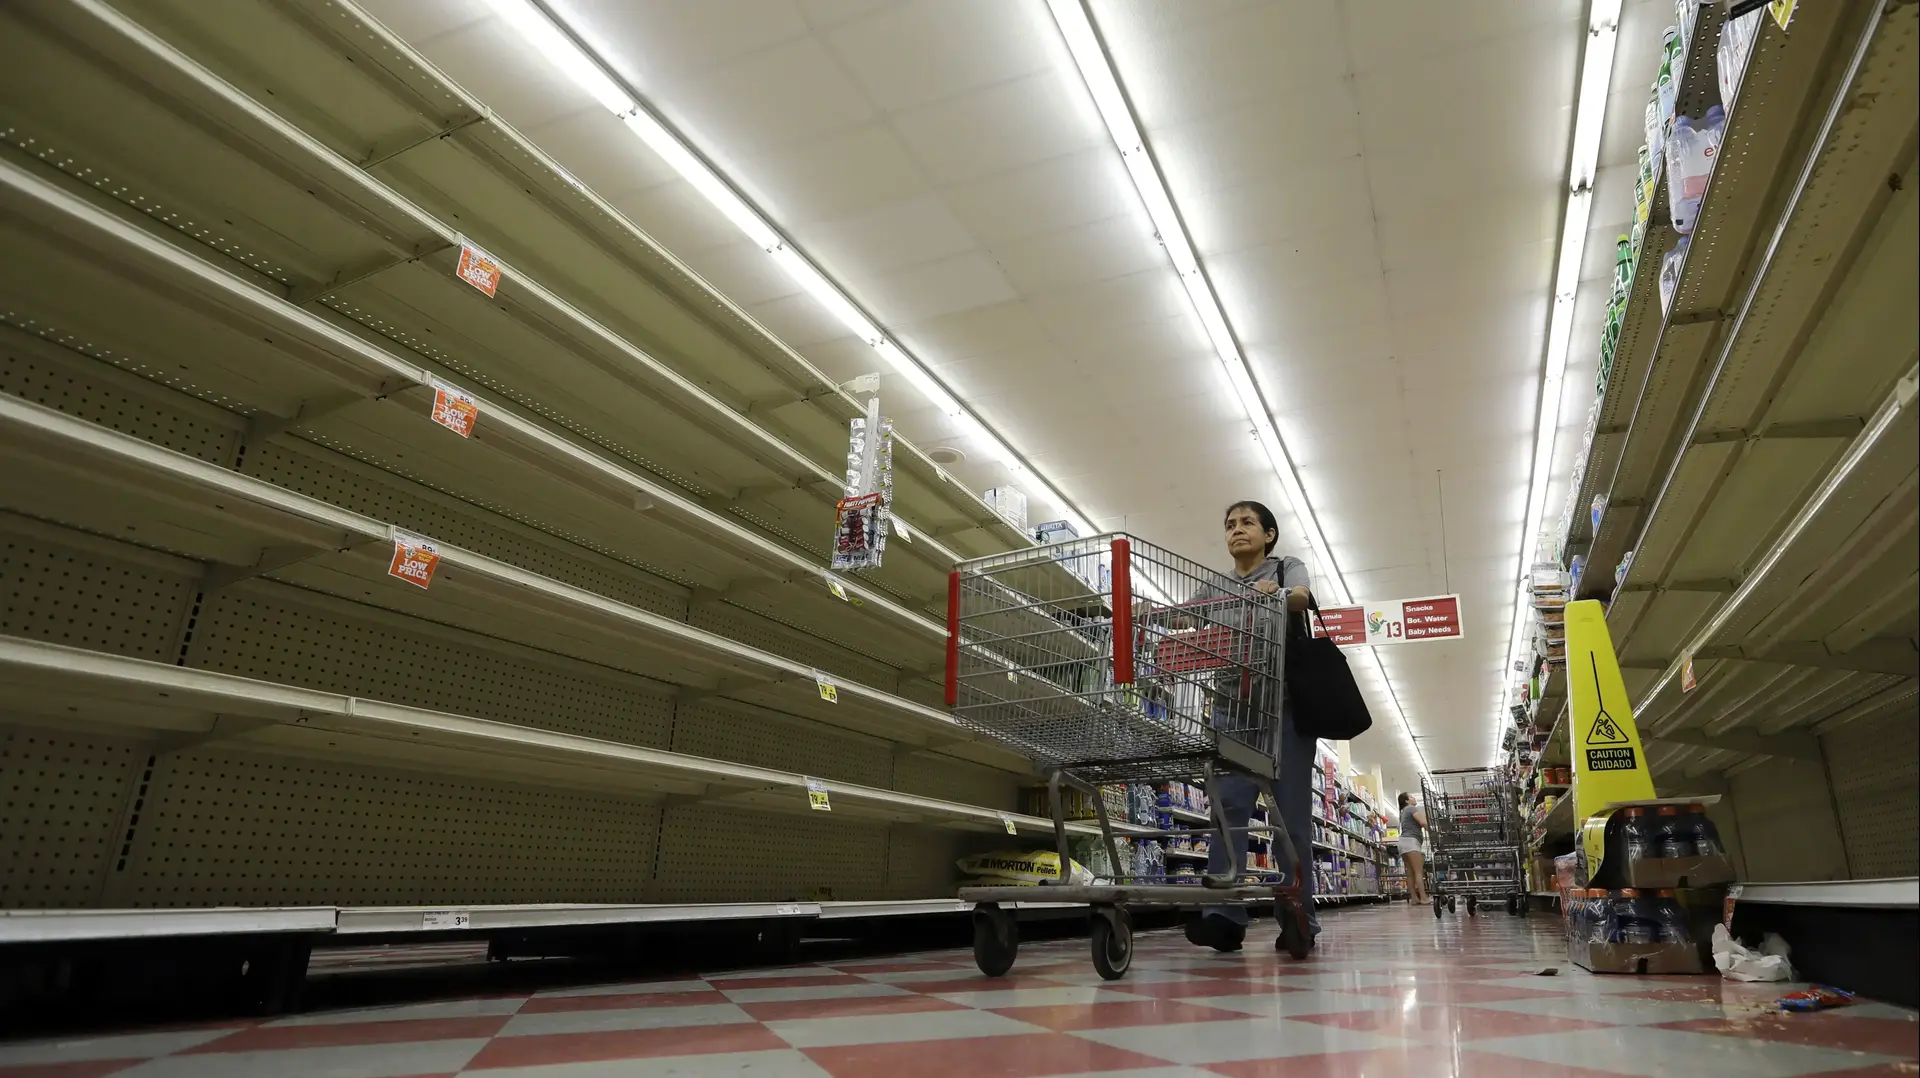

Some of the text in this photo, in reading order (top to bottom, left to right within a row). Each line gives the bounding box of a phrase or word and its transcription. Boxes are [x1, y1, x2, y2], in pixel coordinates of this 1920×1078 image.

[464, 268, 492, 288] PRICE
[469, 264, 490, 280] LOW
[445, 406, 467, 419] LOW
[439, 411, 467, 428] PRICE
[404, 558, 428, 570] LOW
[398, 565, 427, 580] PRICE
[1387, 621, 1402, 638] 13
[1590, 749, 1630, 759] CAUTION
[1591, 759, 1632, 769] CUIDADO
[990, 859, 1035, 872] MORTON
[1036, 866, 1057, 875] Pellets
